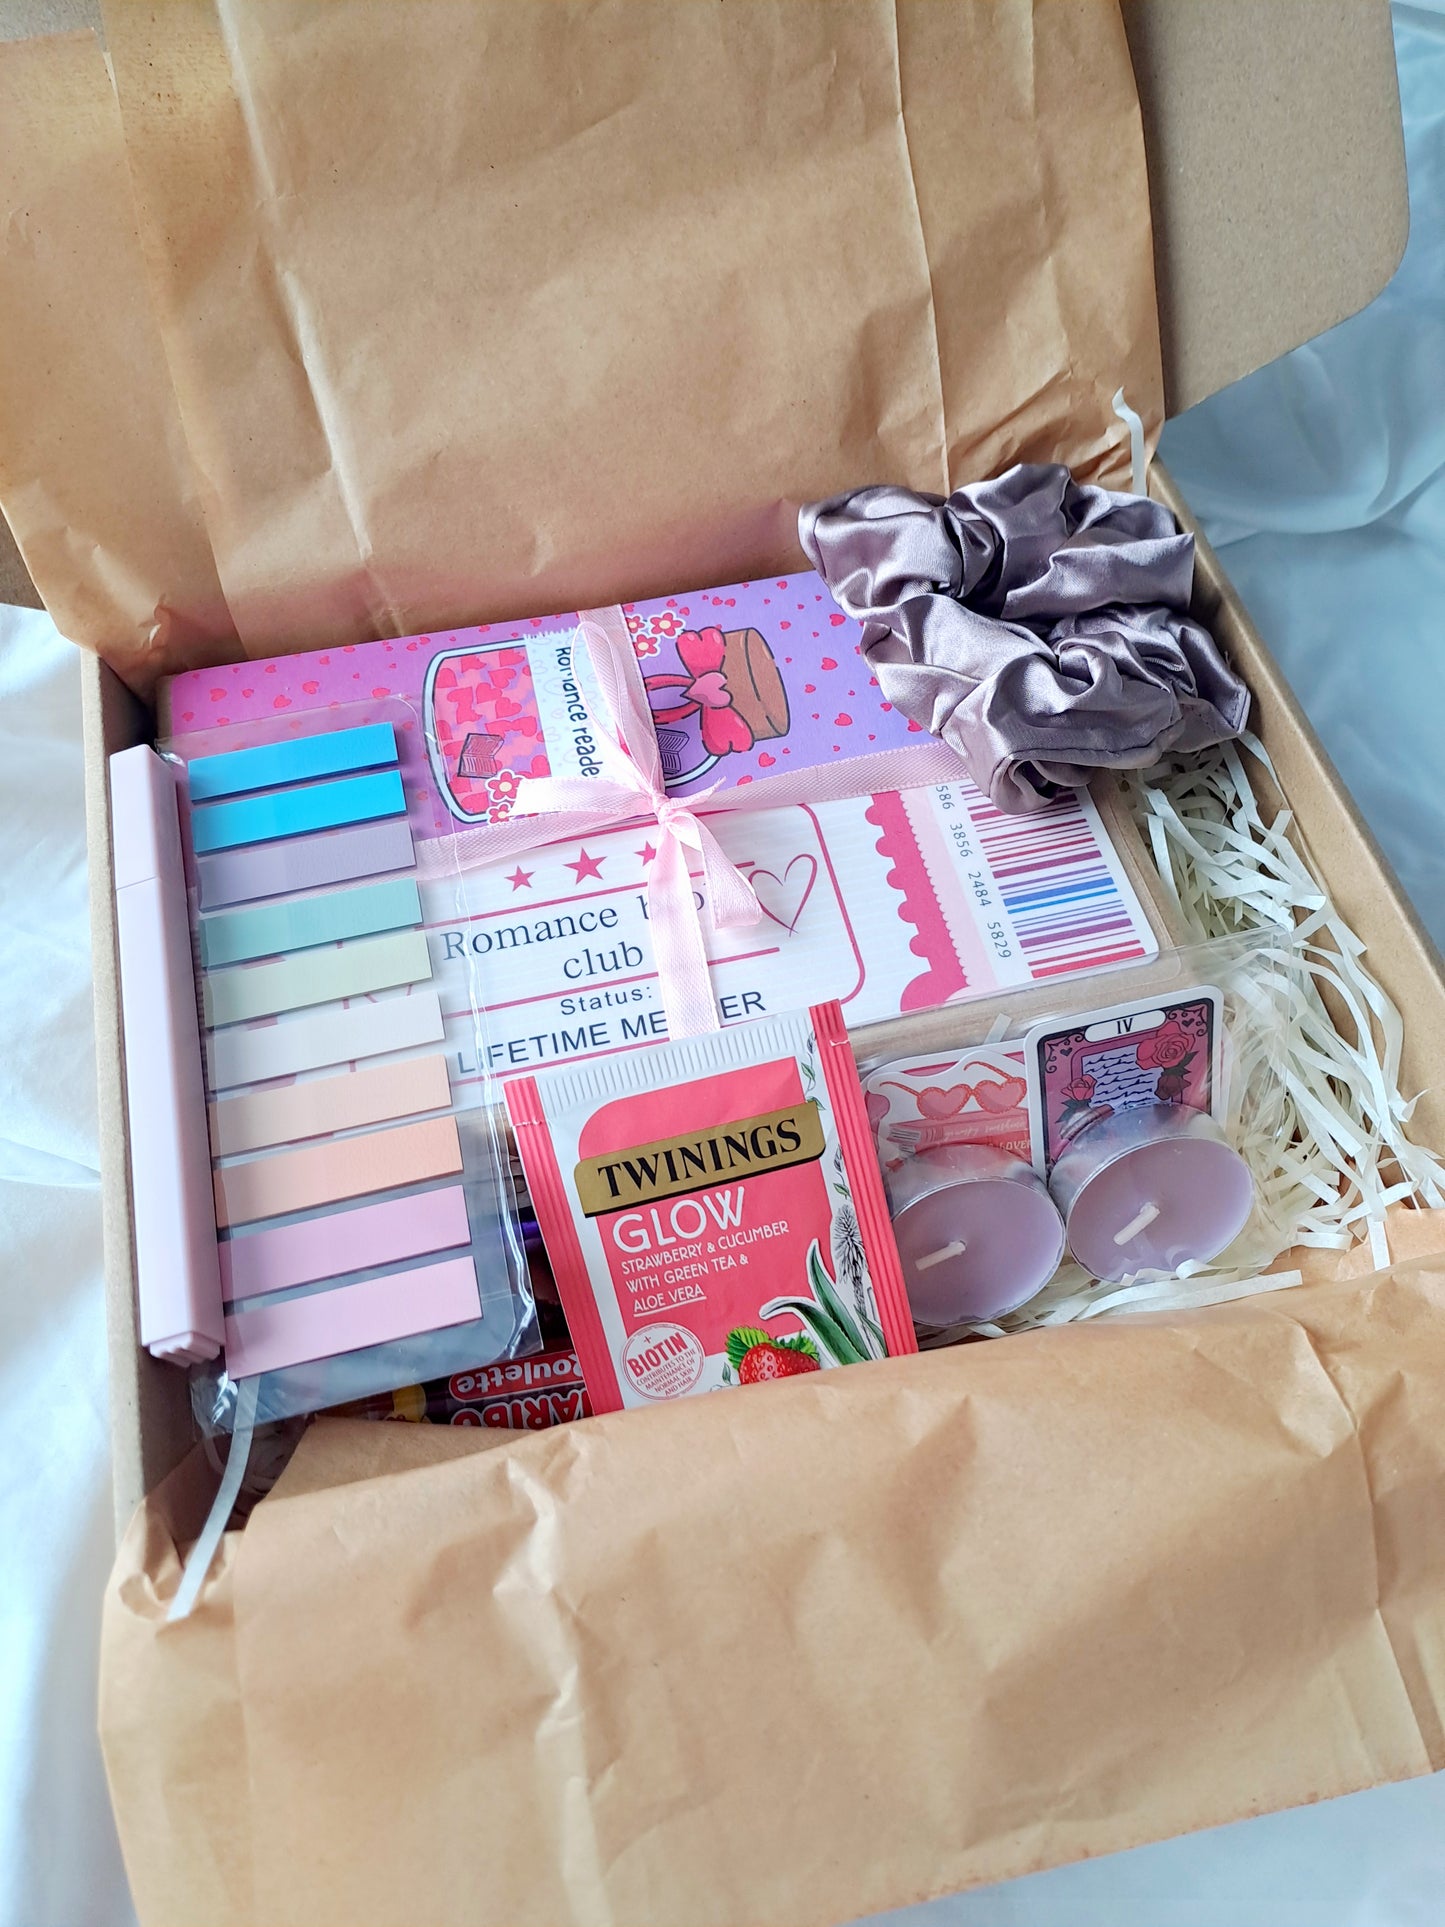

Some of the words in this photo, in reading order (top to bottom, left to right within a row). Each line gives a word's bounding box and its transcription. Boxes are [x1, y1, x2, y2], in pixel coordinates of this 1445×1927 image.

[572, 727, 603, 779] reade
[935, 785, 955, 810] 586
[950, 823, 973, 857] 3856
[968, 871, 992, 907] 2484
[987, 921, 1011, 958] 5829
[440, 907, 619, 960] Romance
[563, 941, 643, 979] club
[560, 985, 652, 1016] Status:
[457, 1022, 610, 1074] LIFETIME
[620, 991, 767, 1040] MEER
[1116, 1017, 1133, 1034] IV
[597, 1118, 801, 1198] TWININGS
[612, 1186, 745, 1253] GLOW
[621, 1242, 703, 1275] STRAWBERRY
[706, 1242, 716, 1254] &
[717, 1220, 789, 1250] CUCUMBER
[626, 1274, 660, 1293] WITH
[663, 1261, 709, 1284] GREEN
[711, 1254, 737, 1273] TEA
[739, 1253, 749, 1265] &
[633, 1294, 665, 1313] ALOE
[668, 1284, 705, 1303] VERA
[627, 1332, 688, 1378] BIOTIN
[636, 1360, 676, 1386] CONTRIBUTES
[645, 1363, 686, 1391] MAINTENANCE
